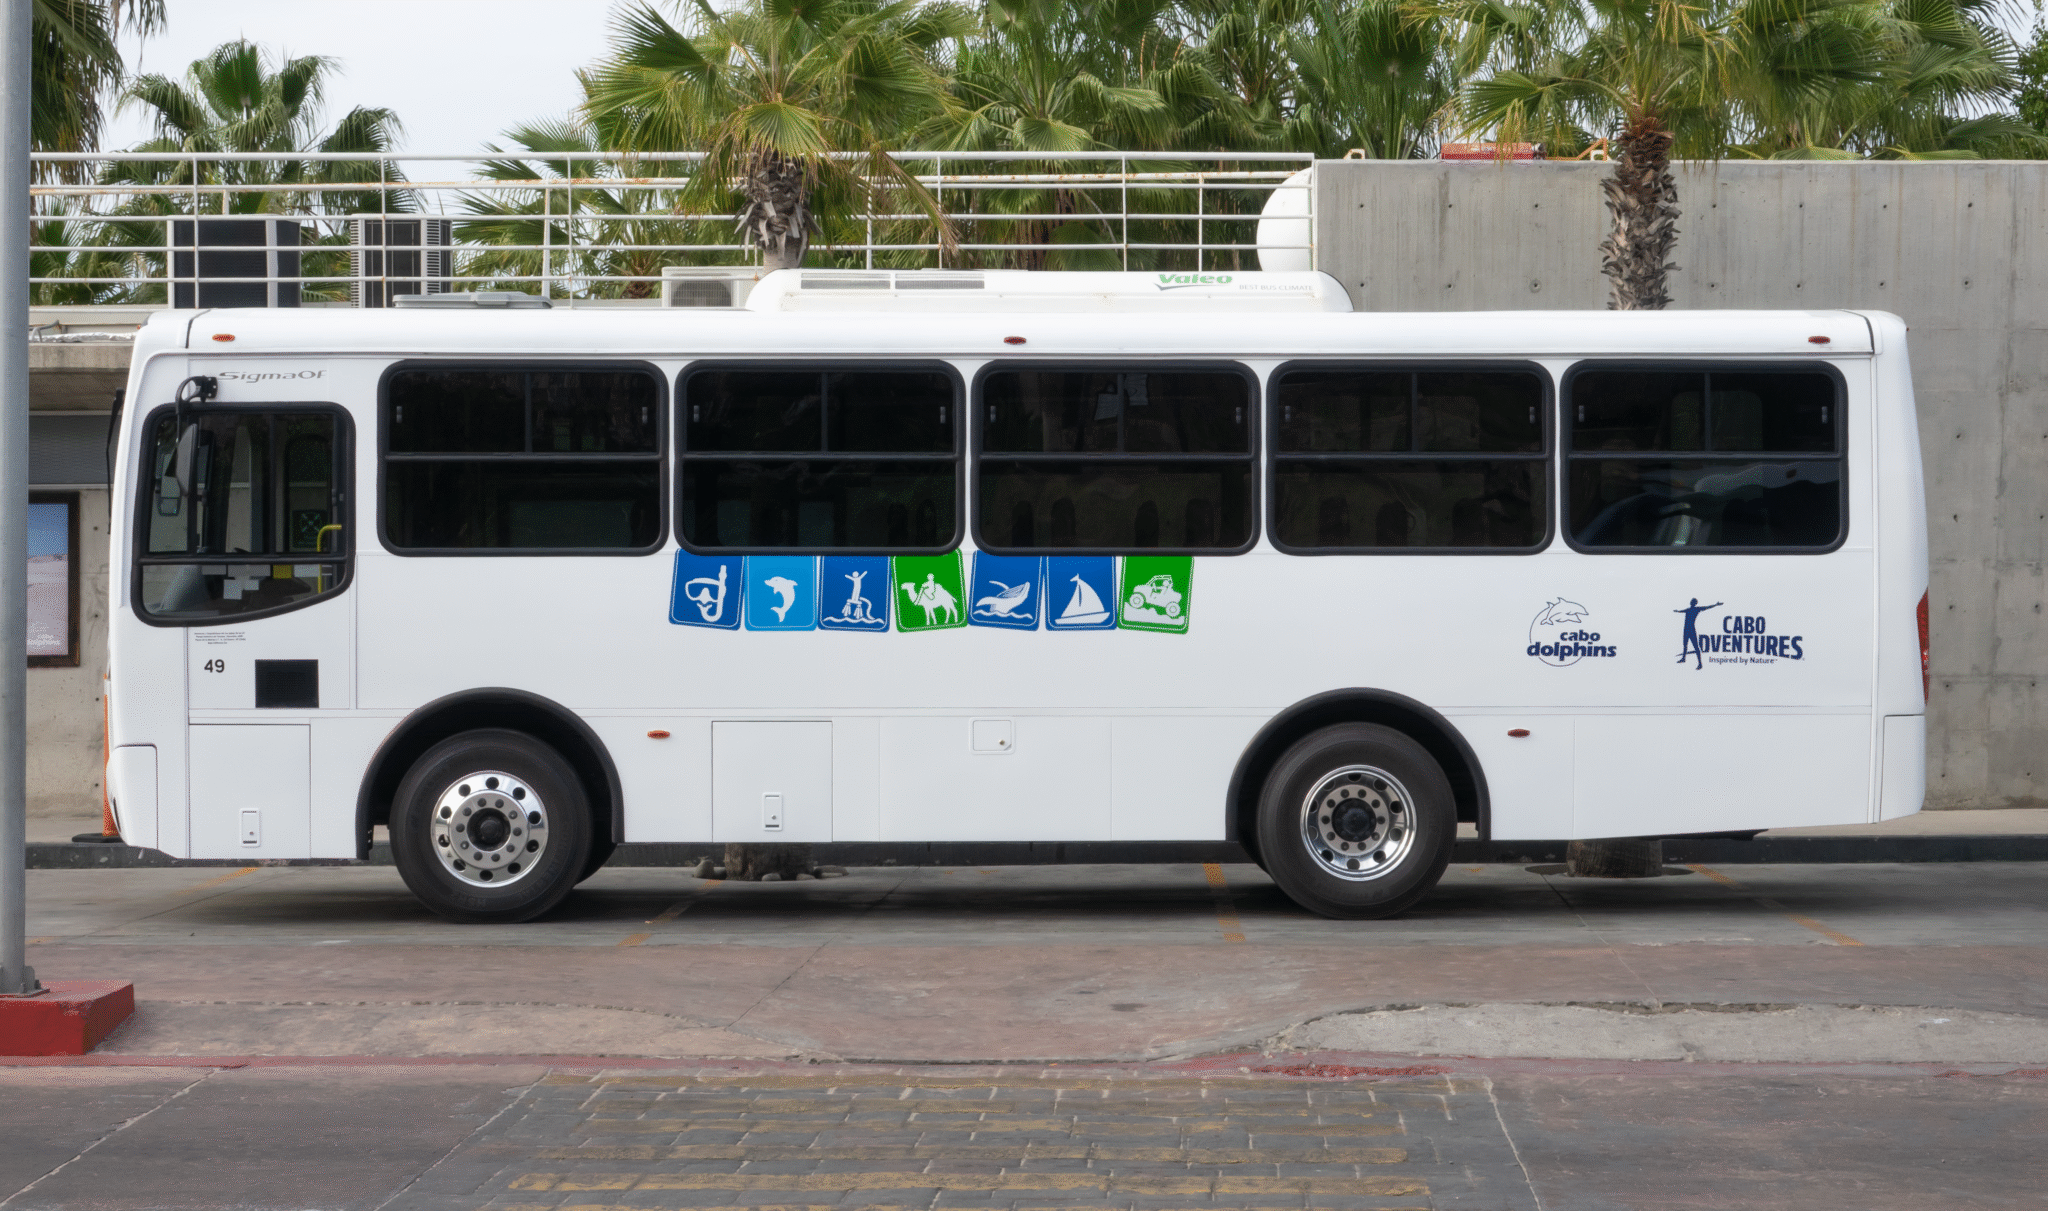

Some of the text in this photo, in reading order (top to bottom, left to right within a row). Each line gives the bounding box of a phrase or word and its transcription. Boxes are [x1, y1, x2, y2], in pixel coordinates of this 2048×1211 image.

[1158, 273, 1233, 284] Valeo
[1722, 615, 1766, 635] CABO
[1559, 629, 1601, 642] cabo
[1526, 641, 1617, 662] dolphins
[204, 658, 226, 674] 49
[1708, 656, 1738, 666] Inspired
[1739, 656, 1749, 666] by
